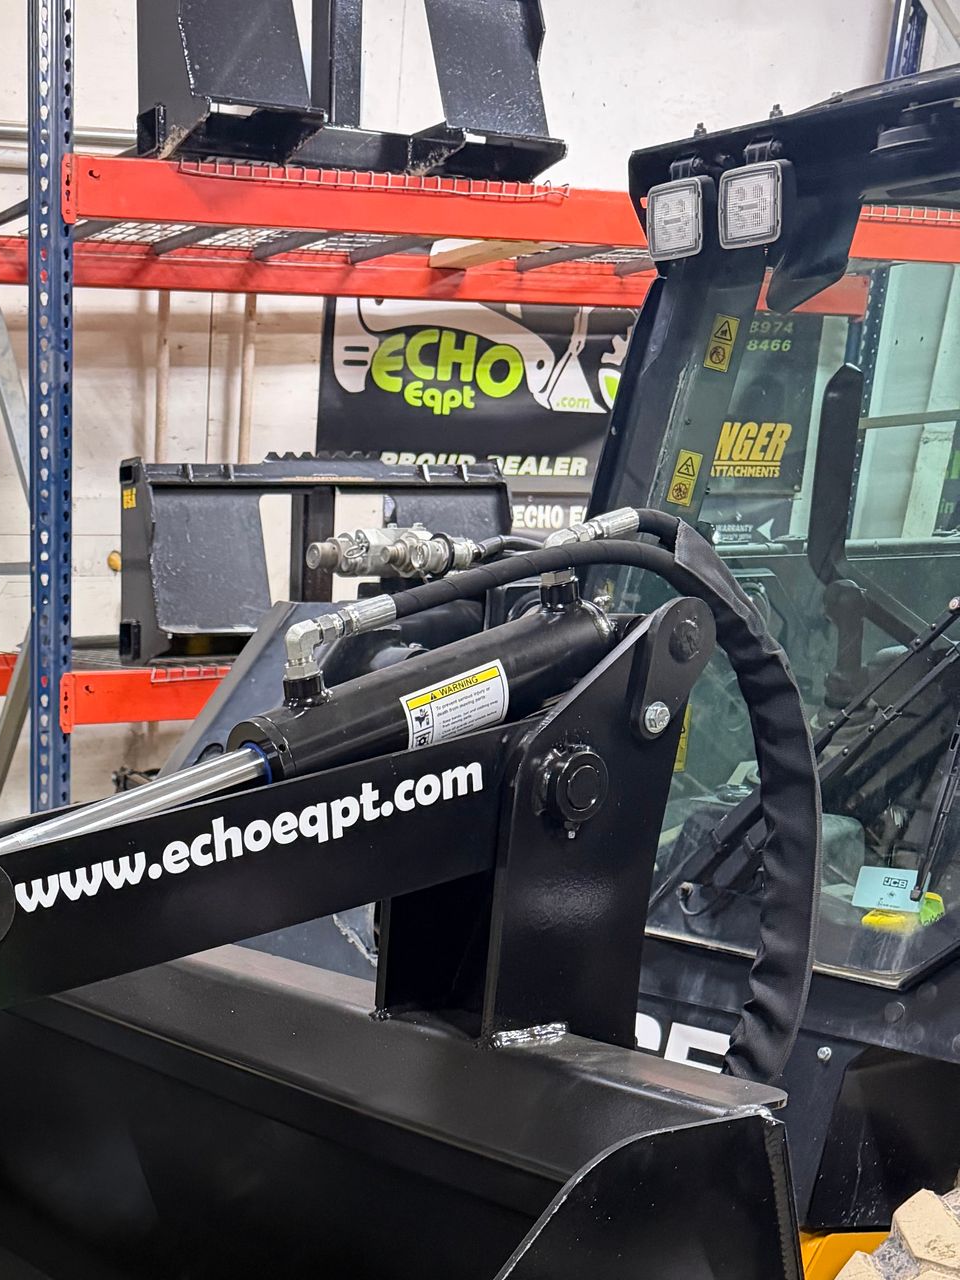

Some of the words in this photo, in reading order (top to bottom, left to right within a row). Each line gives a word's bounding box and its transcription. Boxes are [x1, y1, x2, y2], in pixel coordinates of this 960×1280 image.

[746, 339, 792, 352] 8466
[371, 329, 525, 398] ECHO
[555, 396, 590, 409] .com
[512, 505, 564, 529] ECHO
[439, 676, 478, 696] WARNING
[14, 761, 483, 912] www.echoeqpt.com
[883, 876, 908, 889] JCB
